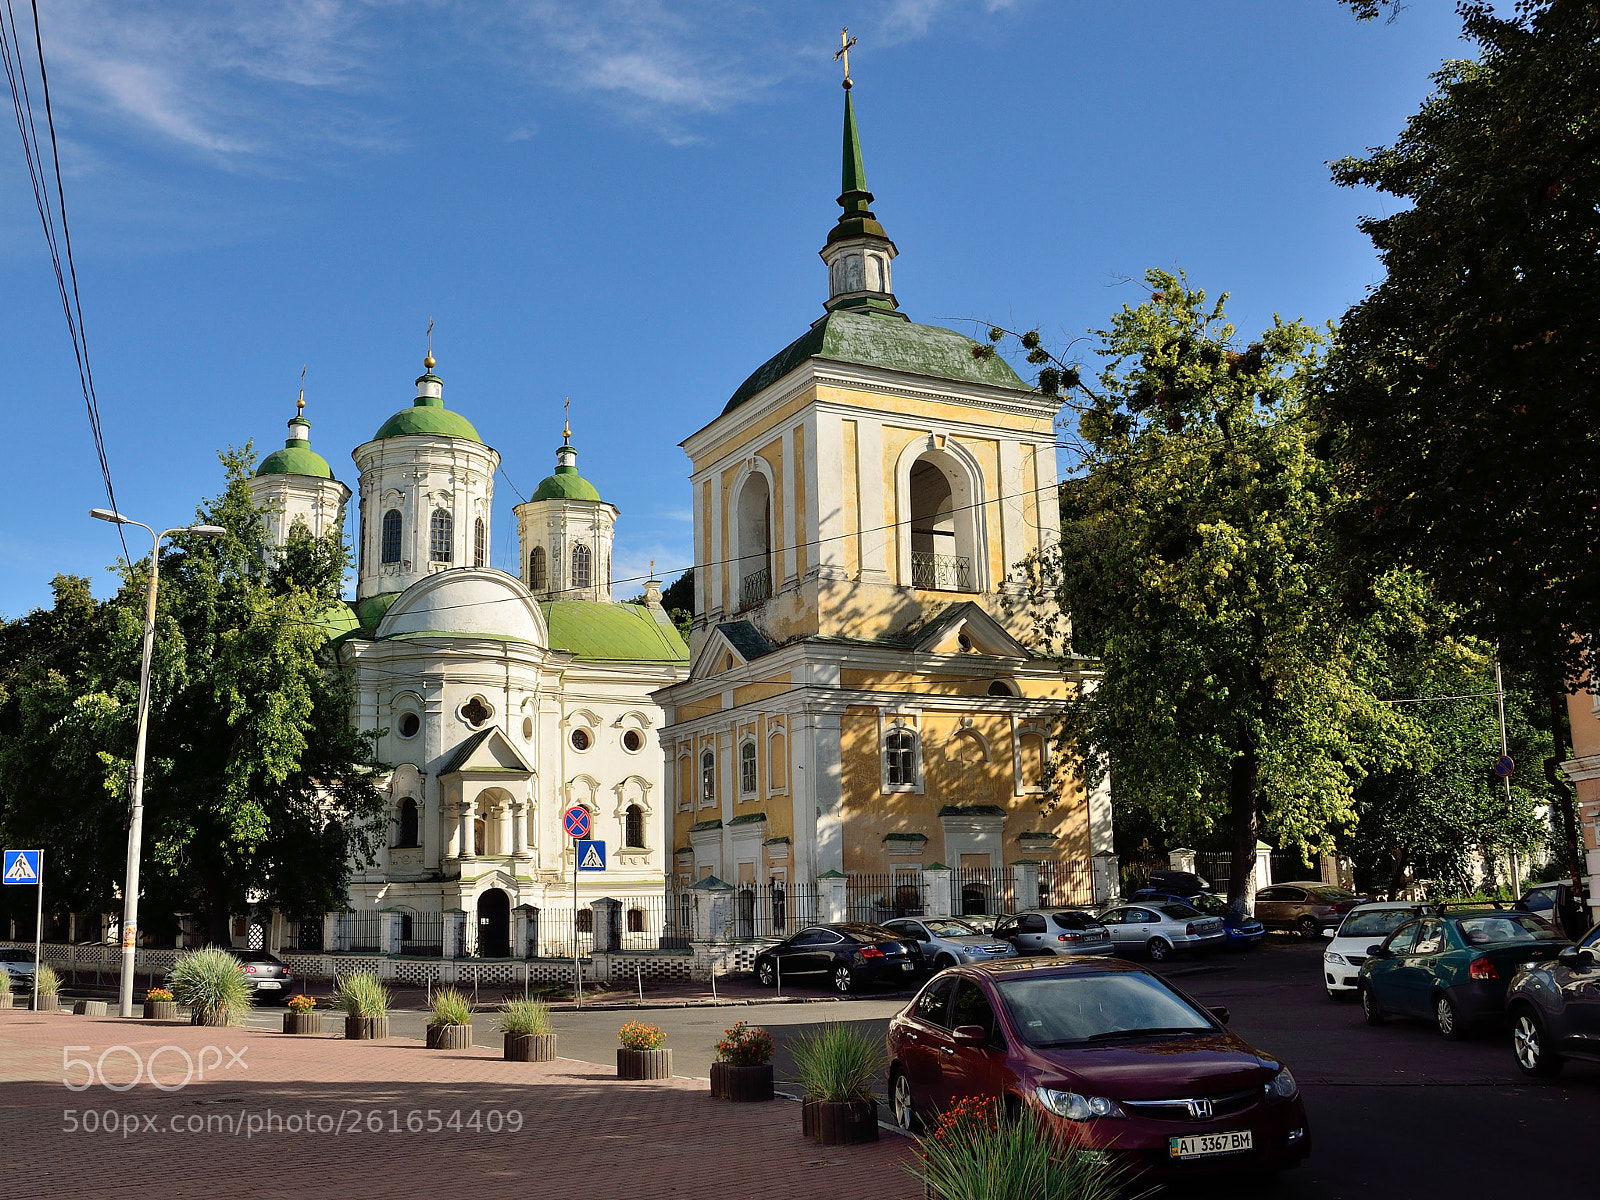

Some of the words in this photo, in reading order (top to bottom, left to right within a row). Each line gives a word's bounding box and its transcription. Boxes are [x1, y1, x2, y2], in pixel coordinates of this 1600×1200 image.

[1180, 1140, 1196, 1154] AI
[1200, 1135, 1228, 1152] 3367
[1231, 1133, 1251, 1149] BM
